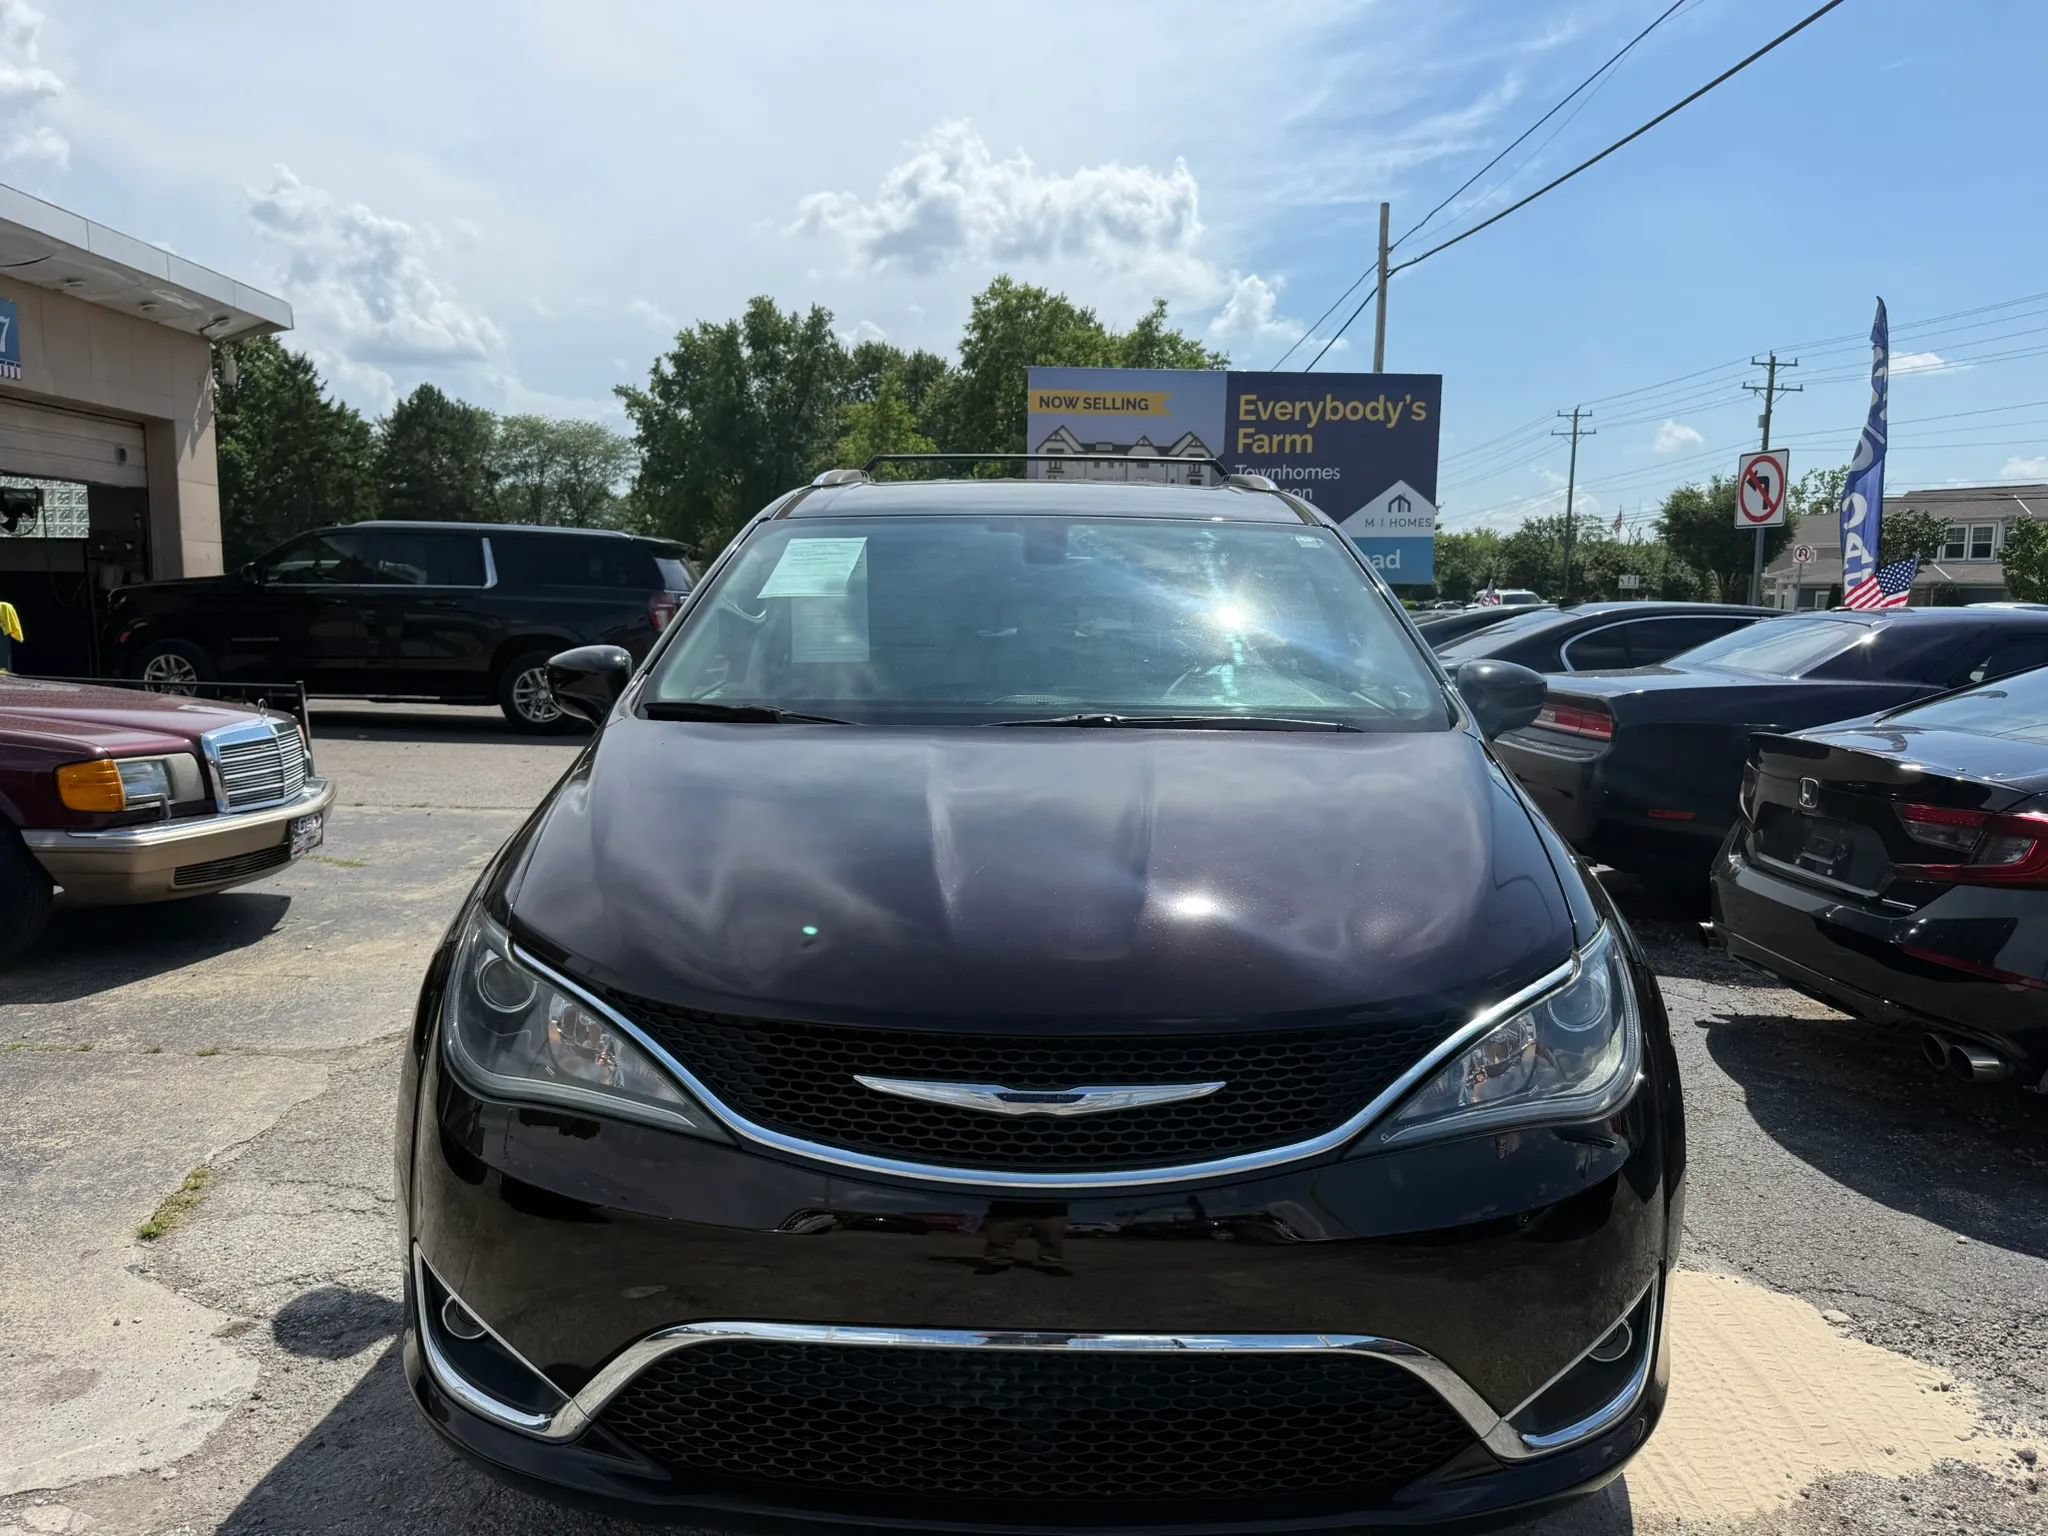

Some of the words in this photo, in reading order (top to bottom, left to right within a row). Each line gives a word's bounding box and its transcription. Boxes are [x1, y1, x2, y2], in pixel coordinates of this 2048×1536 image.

[1039, 395, 1079, 409] NOW
[1083, 397, 1149, 411] SELLING
[1239, 394, 1427, 429] Everybody's
[1237, 427, 1313, 454] Farm
[1235, 464, 1340, 480] Townhomes
[1389, 518, 1432, 528] HOMES
[1370, 549, 1401, 569] ad
